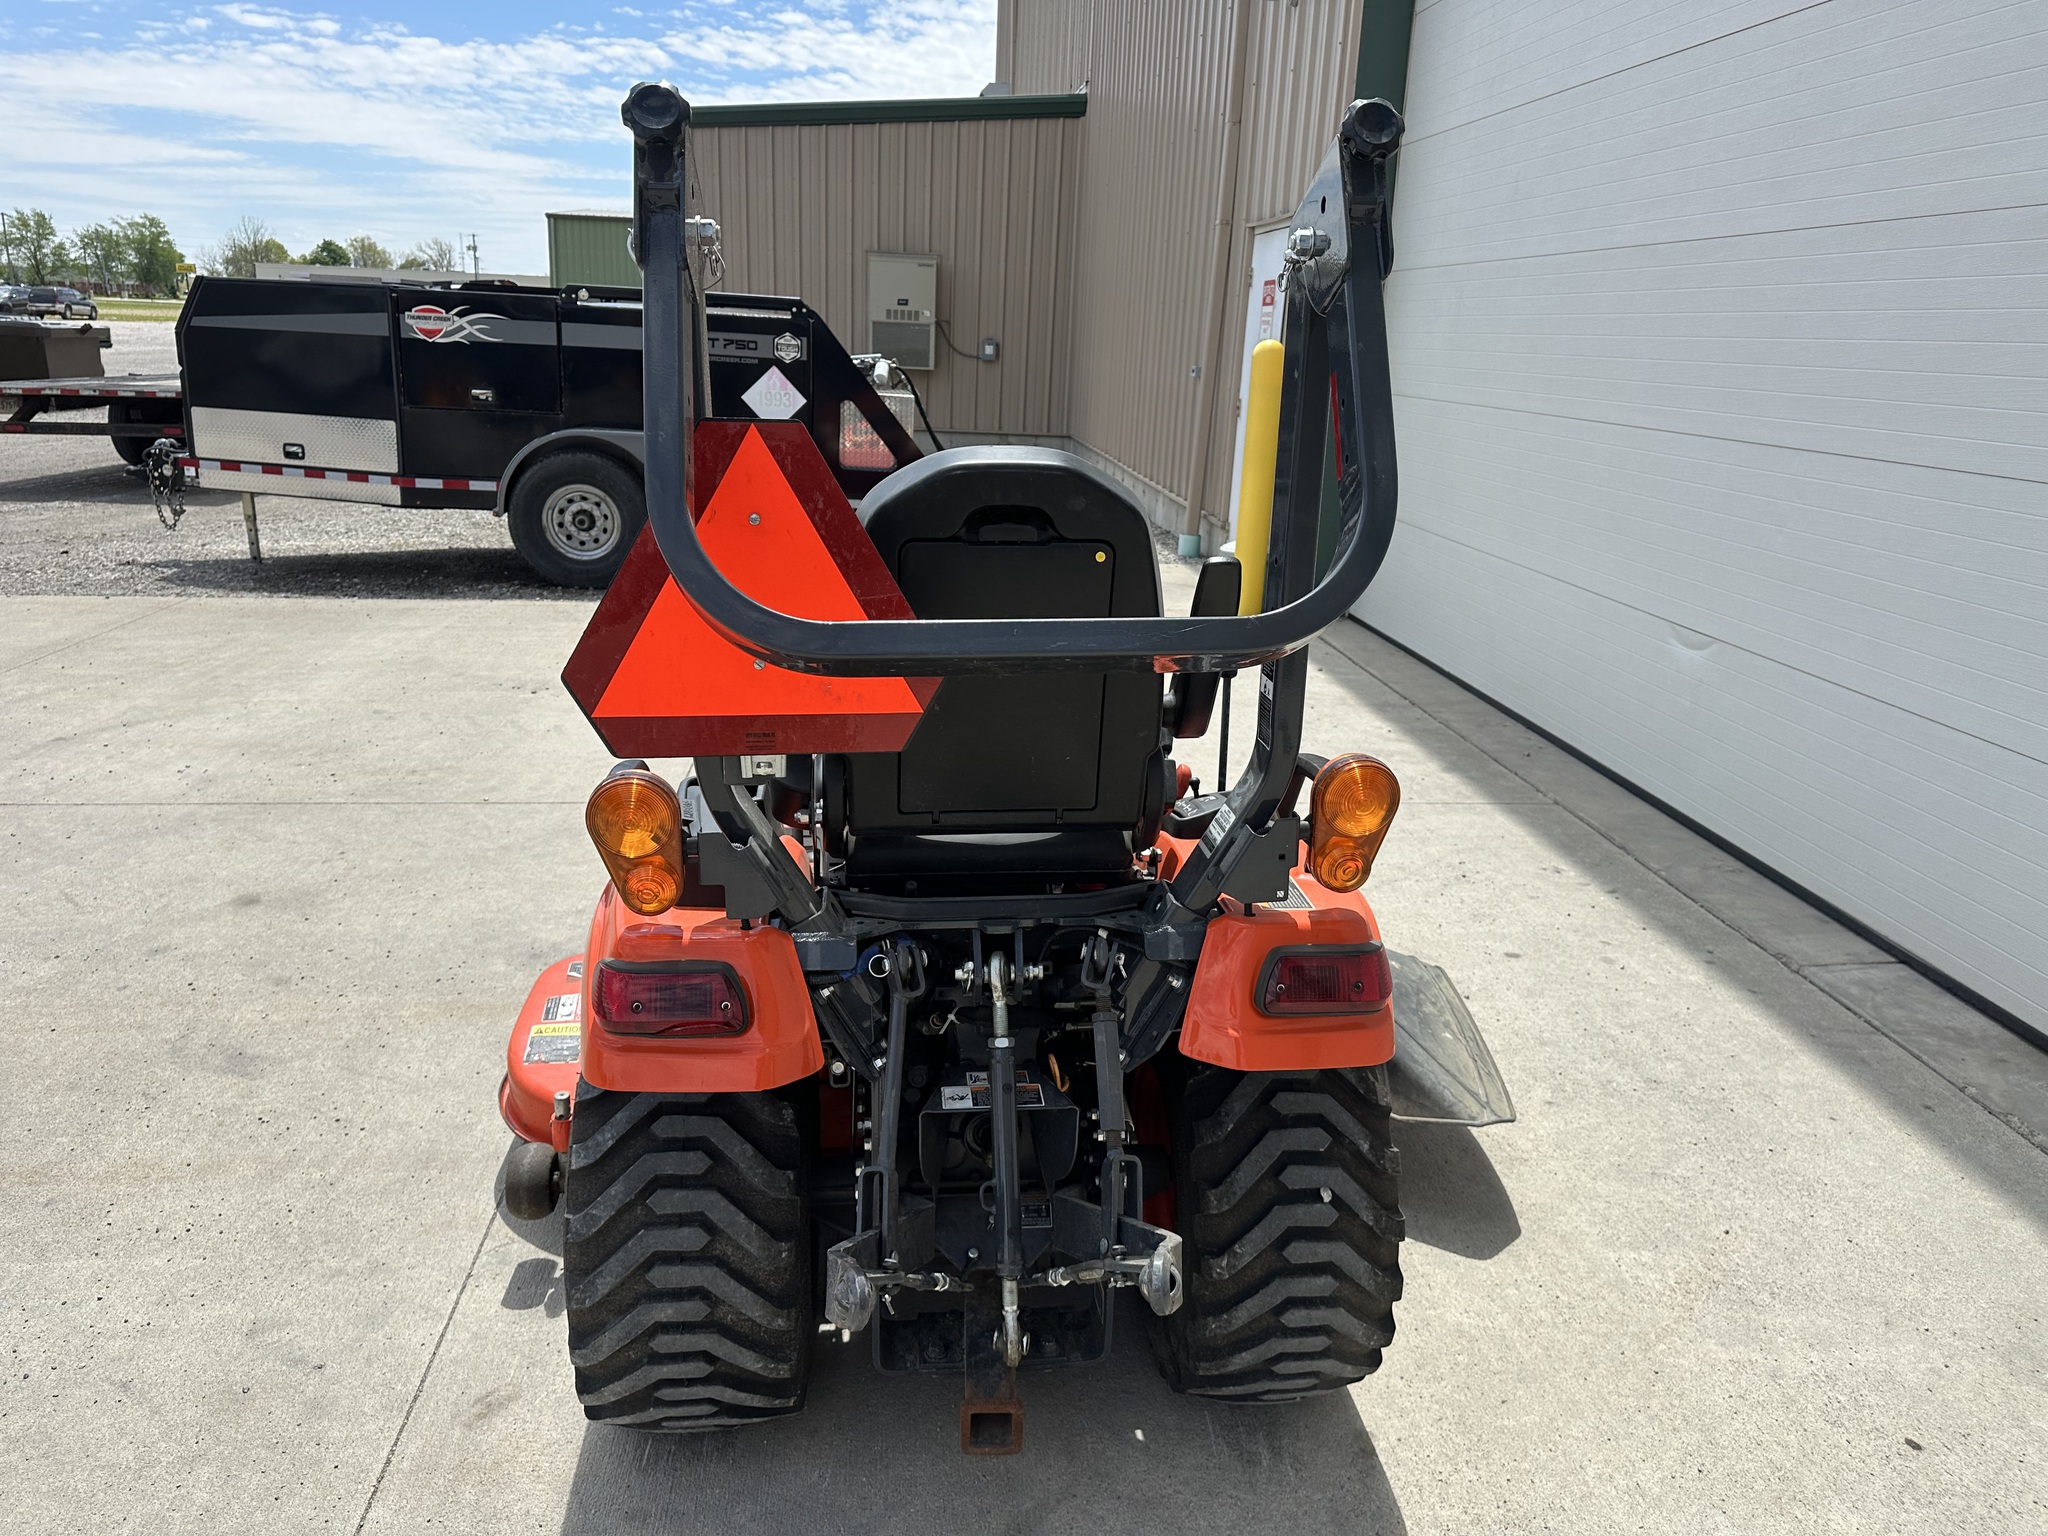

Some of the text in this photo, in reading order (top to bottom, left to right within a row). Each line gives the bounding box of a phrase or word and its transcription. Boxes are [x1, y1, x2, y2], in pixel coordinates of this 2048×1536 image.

[723, 338, 758, 351] 750
[757, 390, 792, 408] 1993
[544, 1026, 581, 1034] CAUTIO
